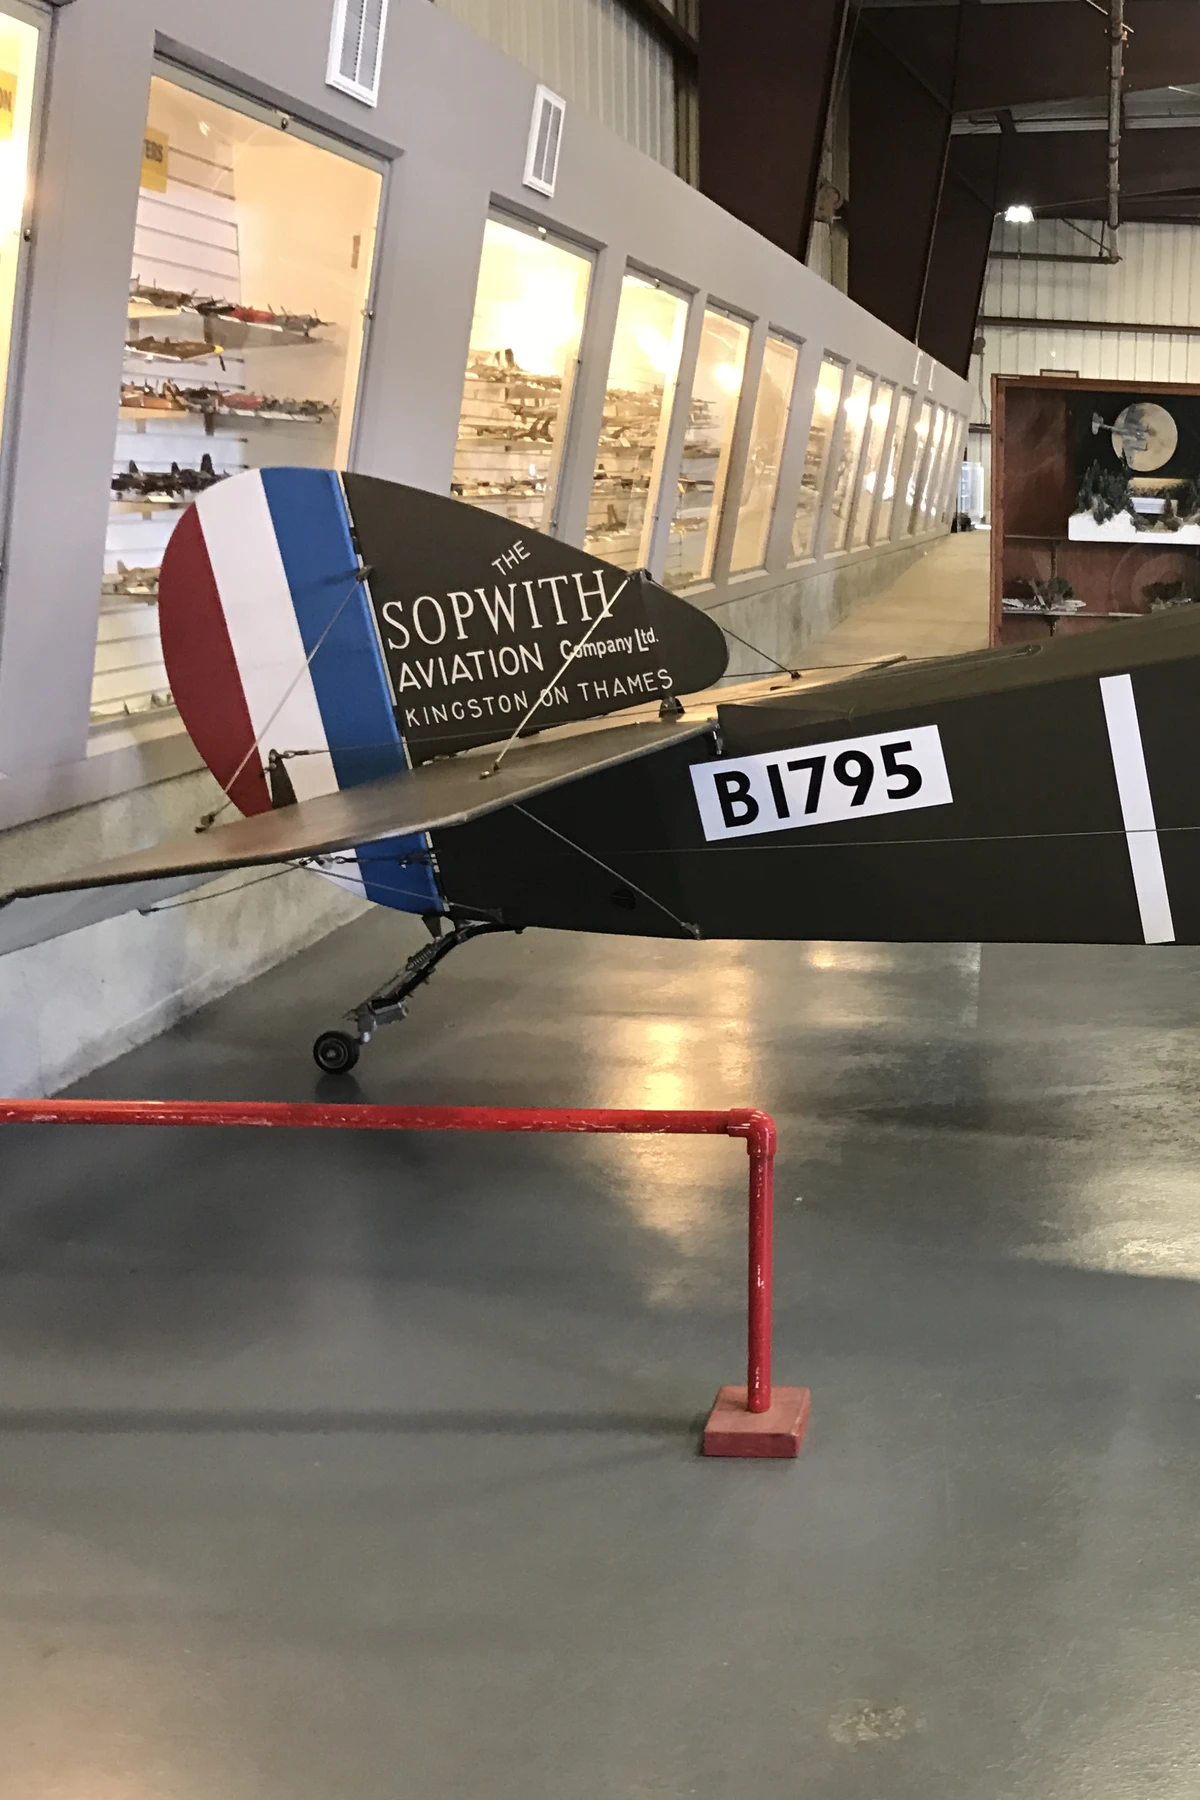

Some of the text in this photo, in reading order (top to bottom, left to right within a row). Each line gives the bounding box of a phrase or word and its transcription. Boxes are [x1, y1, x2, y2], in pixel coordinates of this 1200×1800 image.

[491, 540, 531, 576] THE
[382, 569, 613, 650] SOPWITH
[399, 642, 544, 692] AVIATION
[560, 636, 632, 661] Company
[405, 669, 673, 728] KINGSTON ON THAMES
